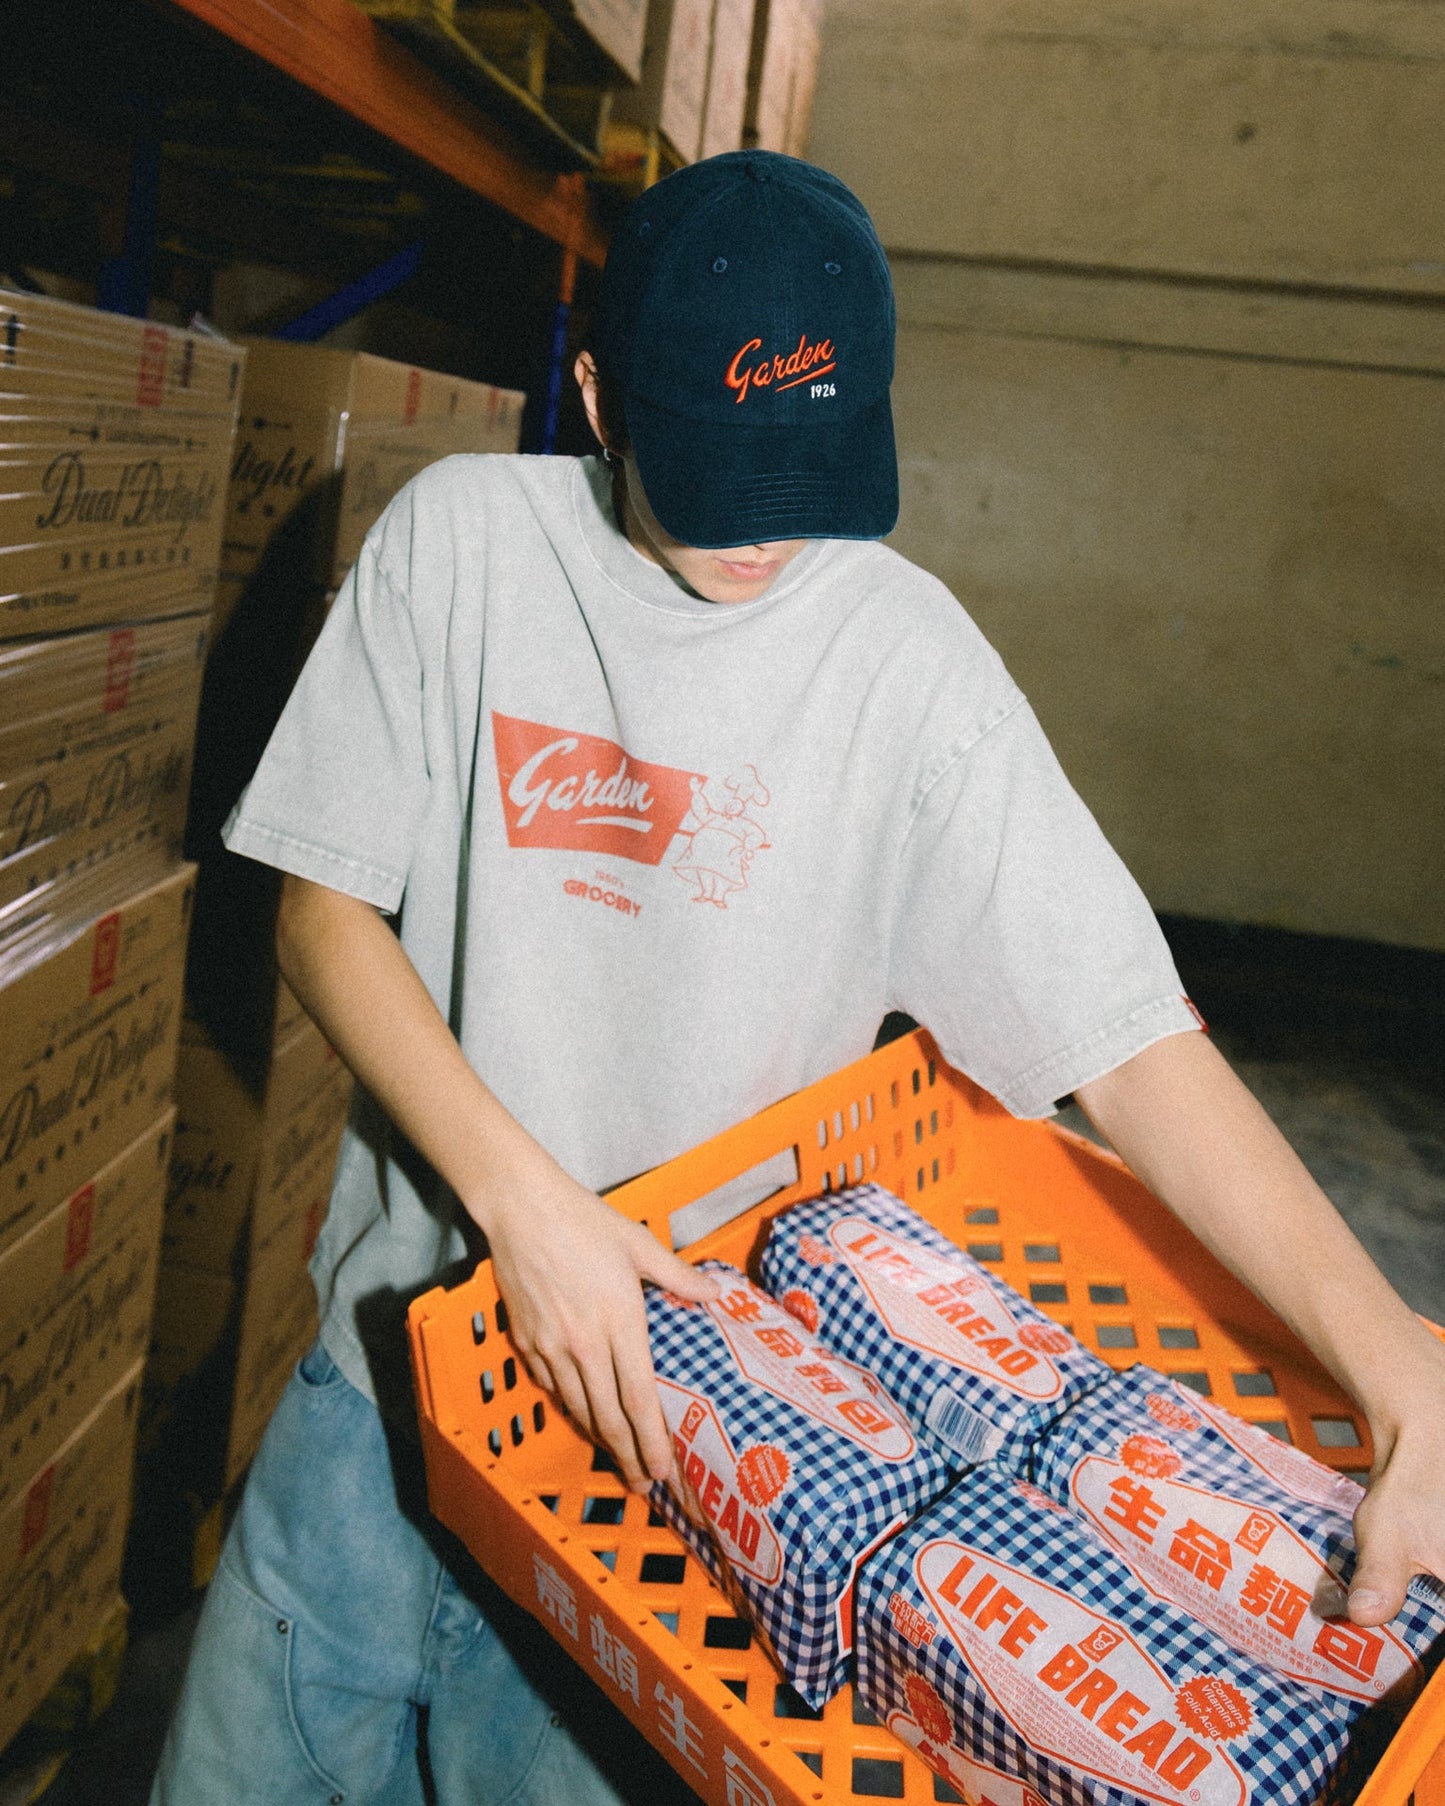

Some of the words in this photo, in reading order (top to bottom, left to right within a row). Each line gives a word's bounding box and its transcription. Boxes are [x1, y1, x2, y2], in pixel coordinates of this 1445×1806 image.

[724, 334, 835, 404] Garden
[810, 383, 836, 399] 1926
[36, 451, 131, 529] Dual
[508, 737, 654, 828] Garden
[562, 879, 642, 919] GROCERY
[916, 1284, 1039, 1377] BREAD
[937, 1555, 1049, 1660] LIFE
[1037, 1643, 1212, 1793] BREAD
[1181, 1691, 1202, 1714] Folic
[1199, 1714, 1221, 1738] Acid
[1201, 1684, 1236, 1729] Vitamins
[1210, 1681, 1247, 1726] Contains
